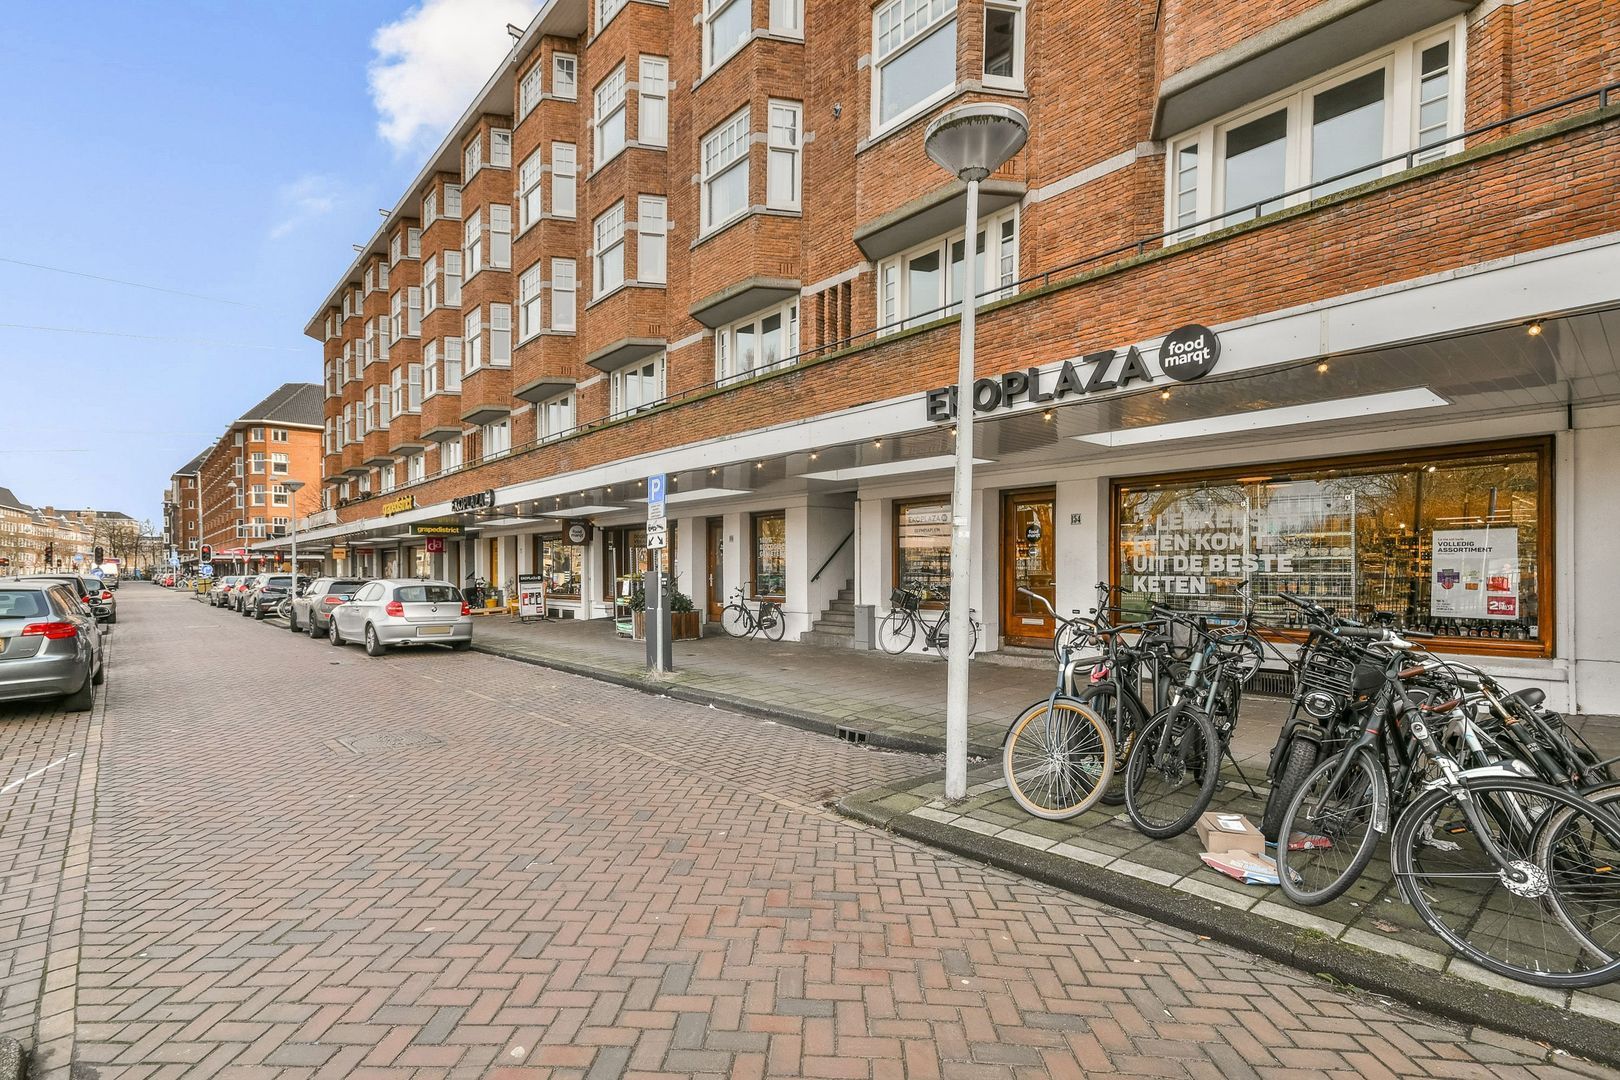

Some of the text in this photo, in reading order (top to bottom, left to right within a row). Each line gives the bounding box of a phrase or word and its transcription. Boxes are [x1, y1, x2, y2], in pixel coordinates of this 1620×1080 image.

[1168, 334, 1204, 355] food
[1164, 346, 1211, 368] marqt
[651, 479, 661, 501] P
[417, 526, 460, 534] grapedistrict
[427, 537, 442, 551] da
[1133, 553, 1293, 573] UIT DE BESTE
[1133, 575, 1206, 594] KETEN
